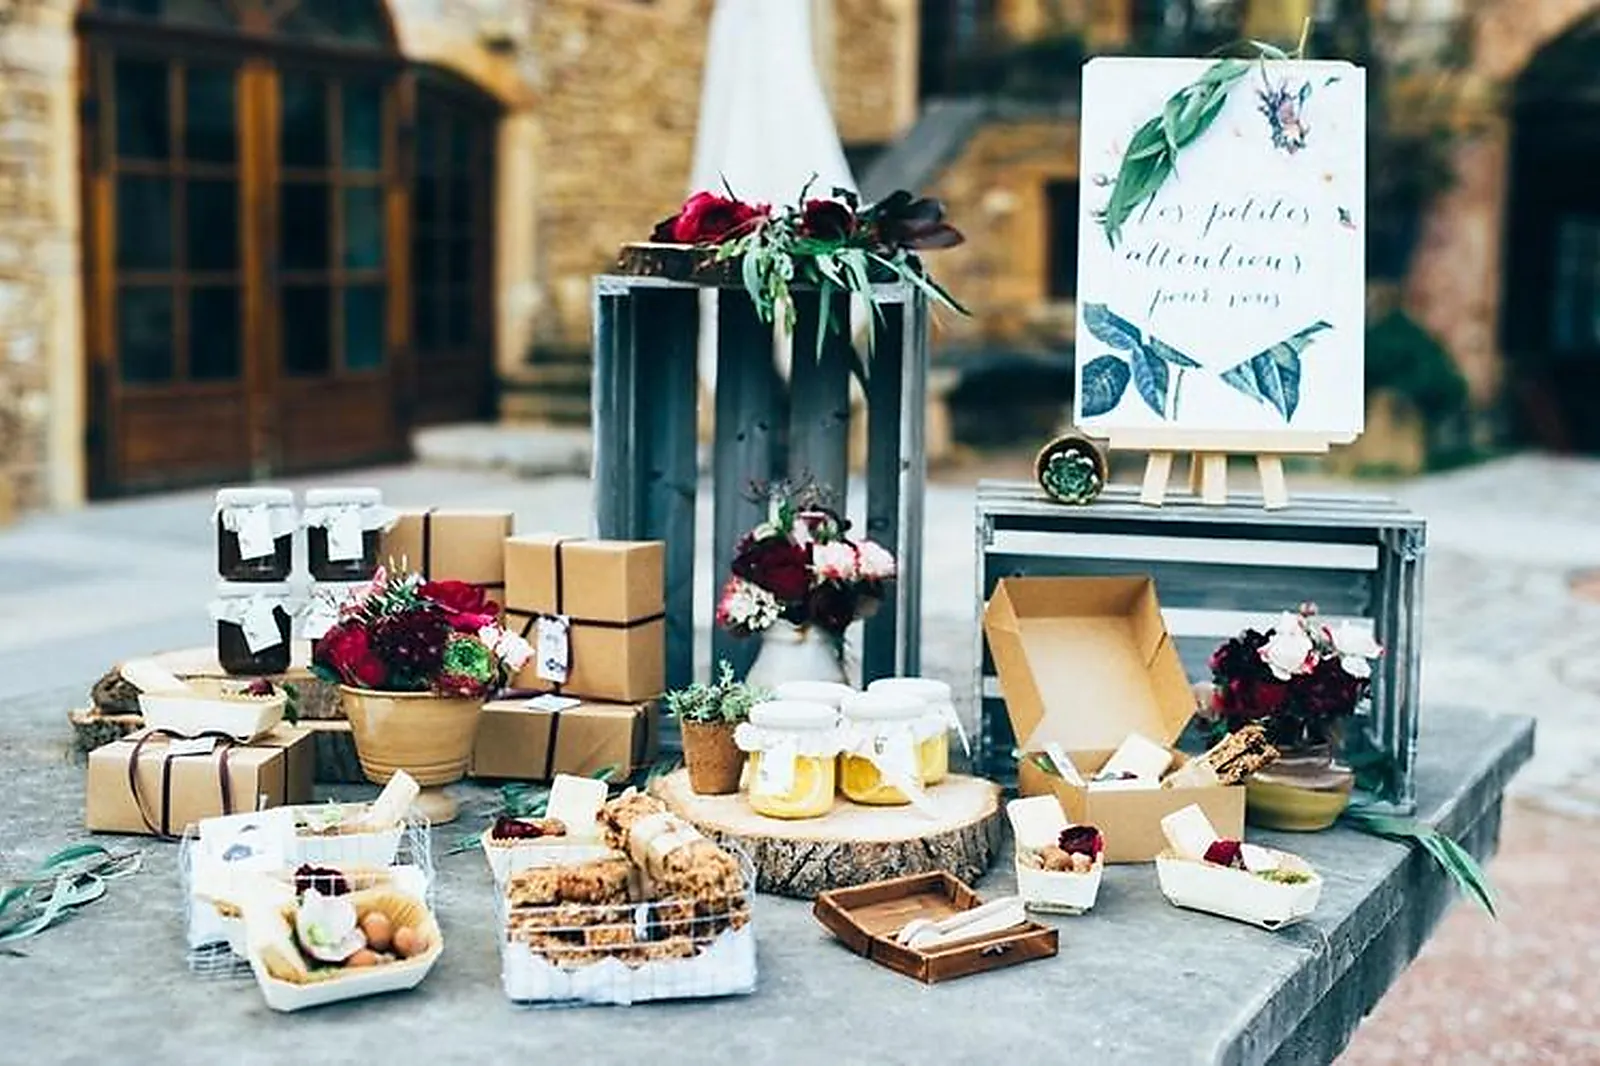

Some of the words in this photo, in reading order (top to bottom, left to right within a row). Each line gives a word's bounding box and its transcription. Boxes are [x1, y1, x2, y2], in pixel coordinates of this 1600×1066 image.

[1199, 198, 1310, 239] petites
[1124, 241, 1302, 275] attentions
[1148, 288, 1210, 317] pour
[1227, 292, 1282, 309] vous
